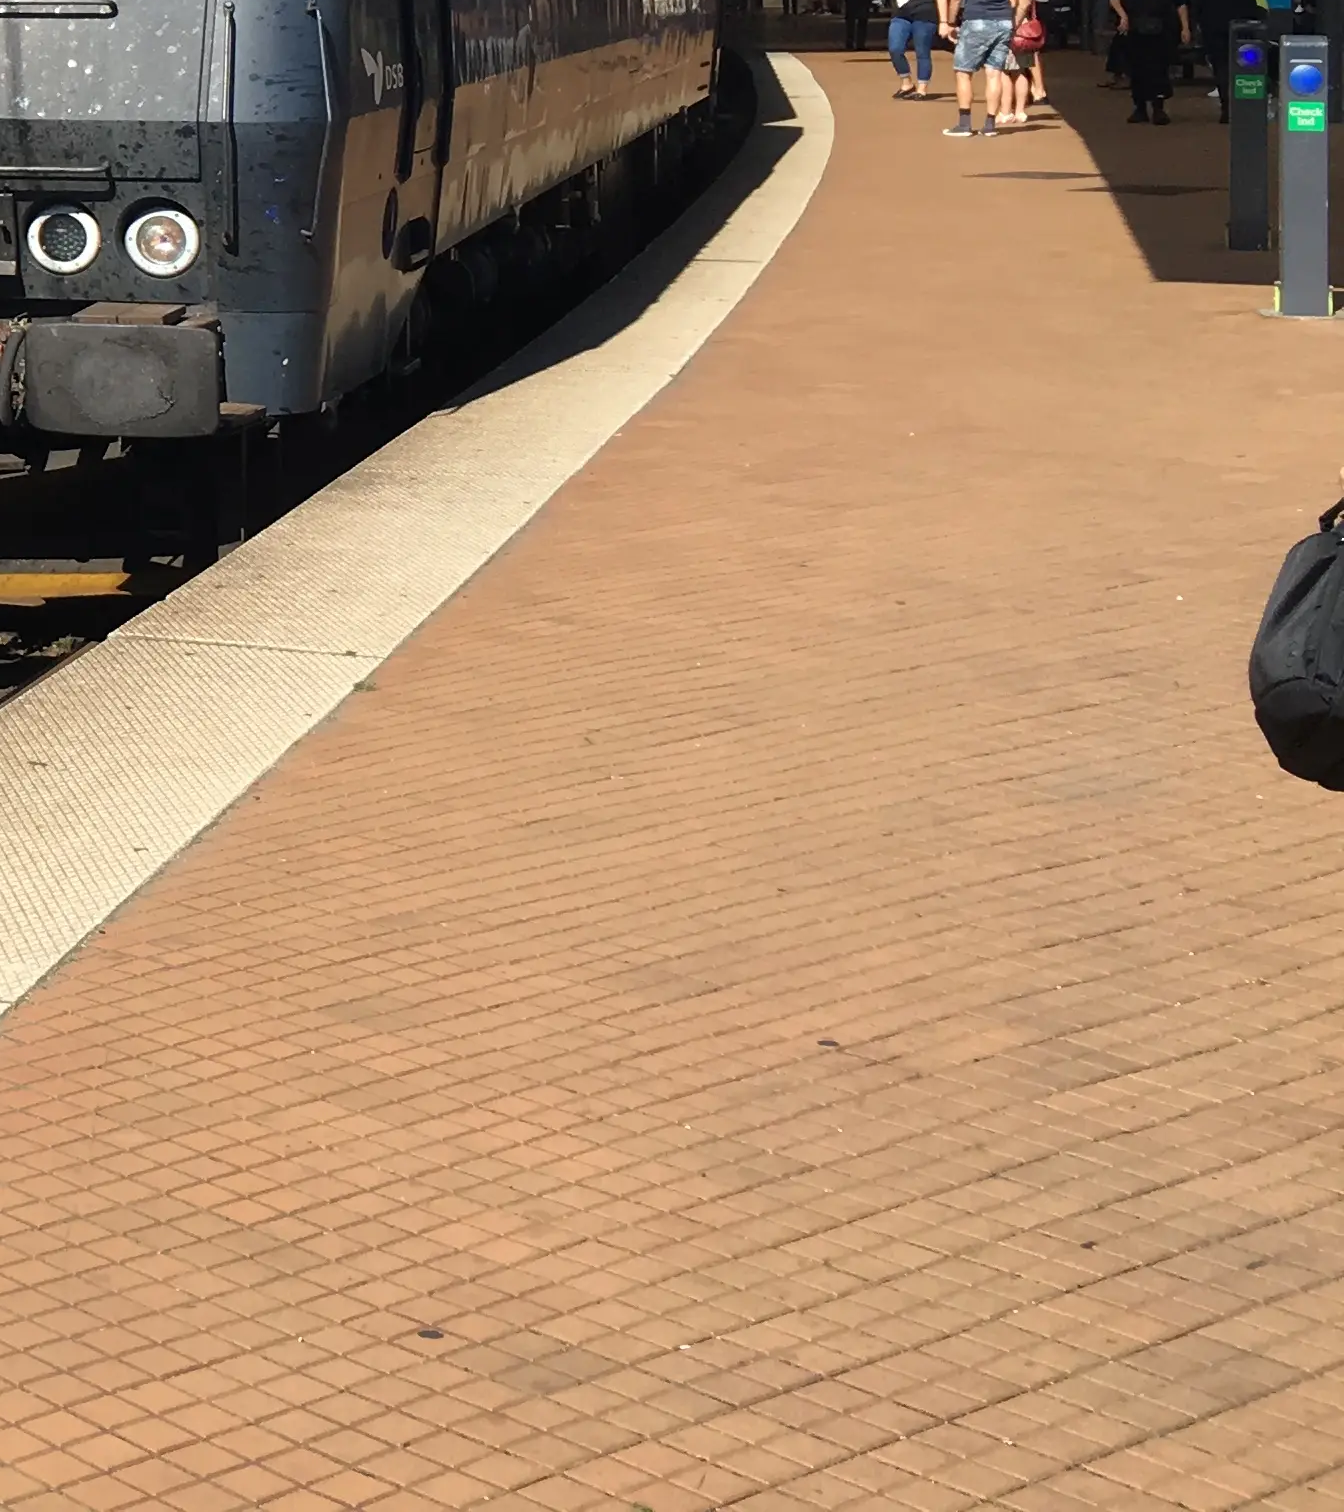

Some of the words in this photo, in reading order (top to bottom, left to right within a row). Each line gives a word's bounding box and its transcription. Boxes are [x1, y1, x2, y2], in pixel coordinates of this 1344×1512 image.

[385, 63, 404, 90] DSB
[1235, 78, 1263, 87] Check
[1288, 106, 1324, 117] Check
